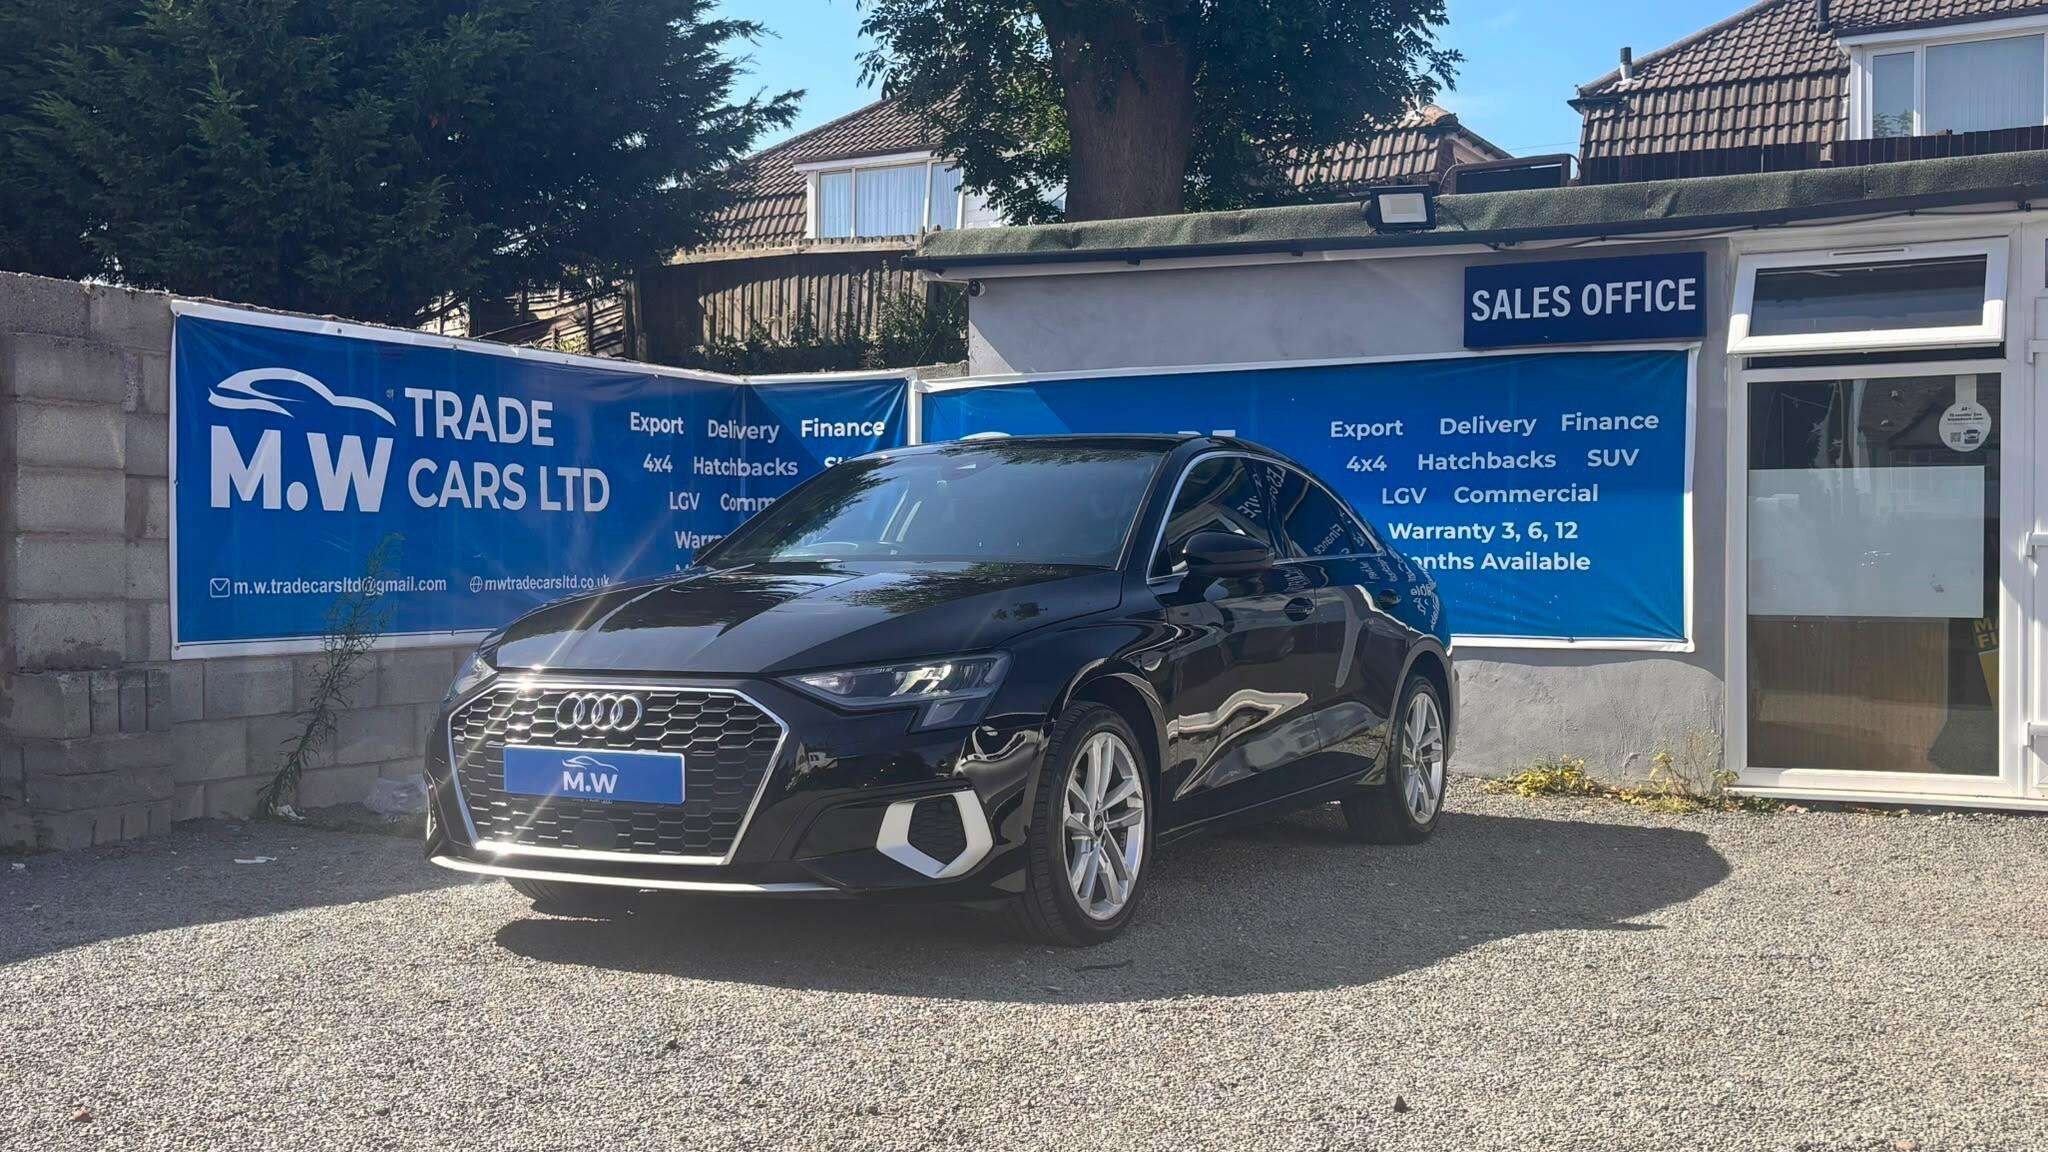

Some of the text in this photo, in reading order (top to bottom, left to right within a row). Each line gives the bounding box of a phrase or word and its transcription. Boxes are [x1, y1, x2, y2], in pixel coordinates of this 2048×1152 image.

[1471, 278, 1697, 321] SALES OFFICE
[405, 387, 555, 447] TRADE
[630, 411, 885, 443] Export Delivery Finance
[1330, 412, 1659, 440] Export Delivery Finance
[211, 425, 394, 513] M.W
[643, 454, 673, 473] 4x4
[693, 456, 799, 477] Hatchbacks
[1346, 449, 1640, 473] 4x4 Hatchbacks SUV
[407, 458, 610, 512] CARS LTD
[1382, 484, 1599, 505] LGV Commercial
[669, 492, 700, 511] LGV
[1389, 521, 1578, 543] Warranty 3, 6, 12
[1403, 553, 1474, 570] onths
[1480, 551, 1591, 571] Available
[234, 574, 610, 596] m.w.tradecarsltd@gmail.com mwtradecarsltd.co.uk
[564, 771, 618, 793] M.W
